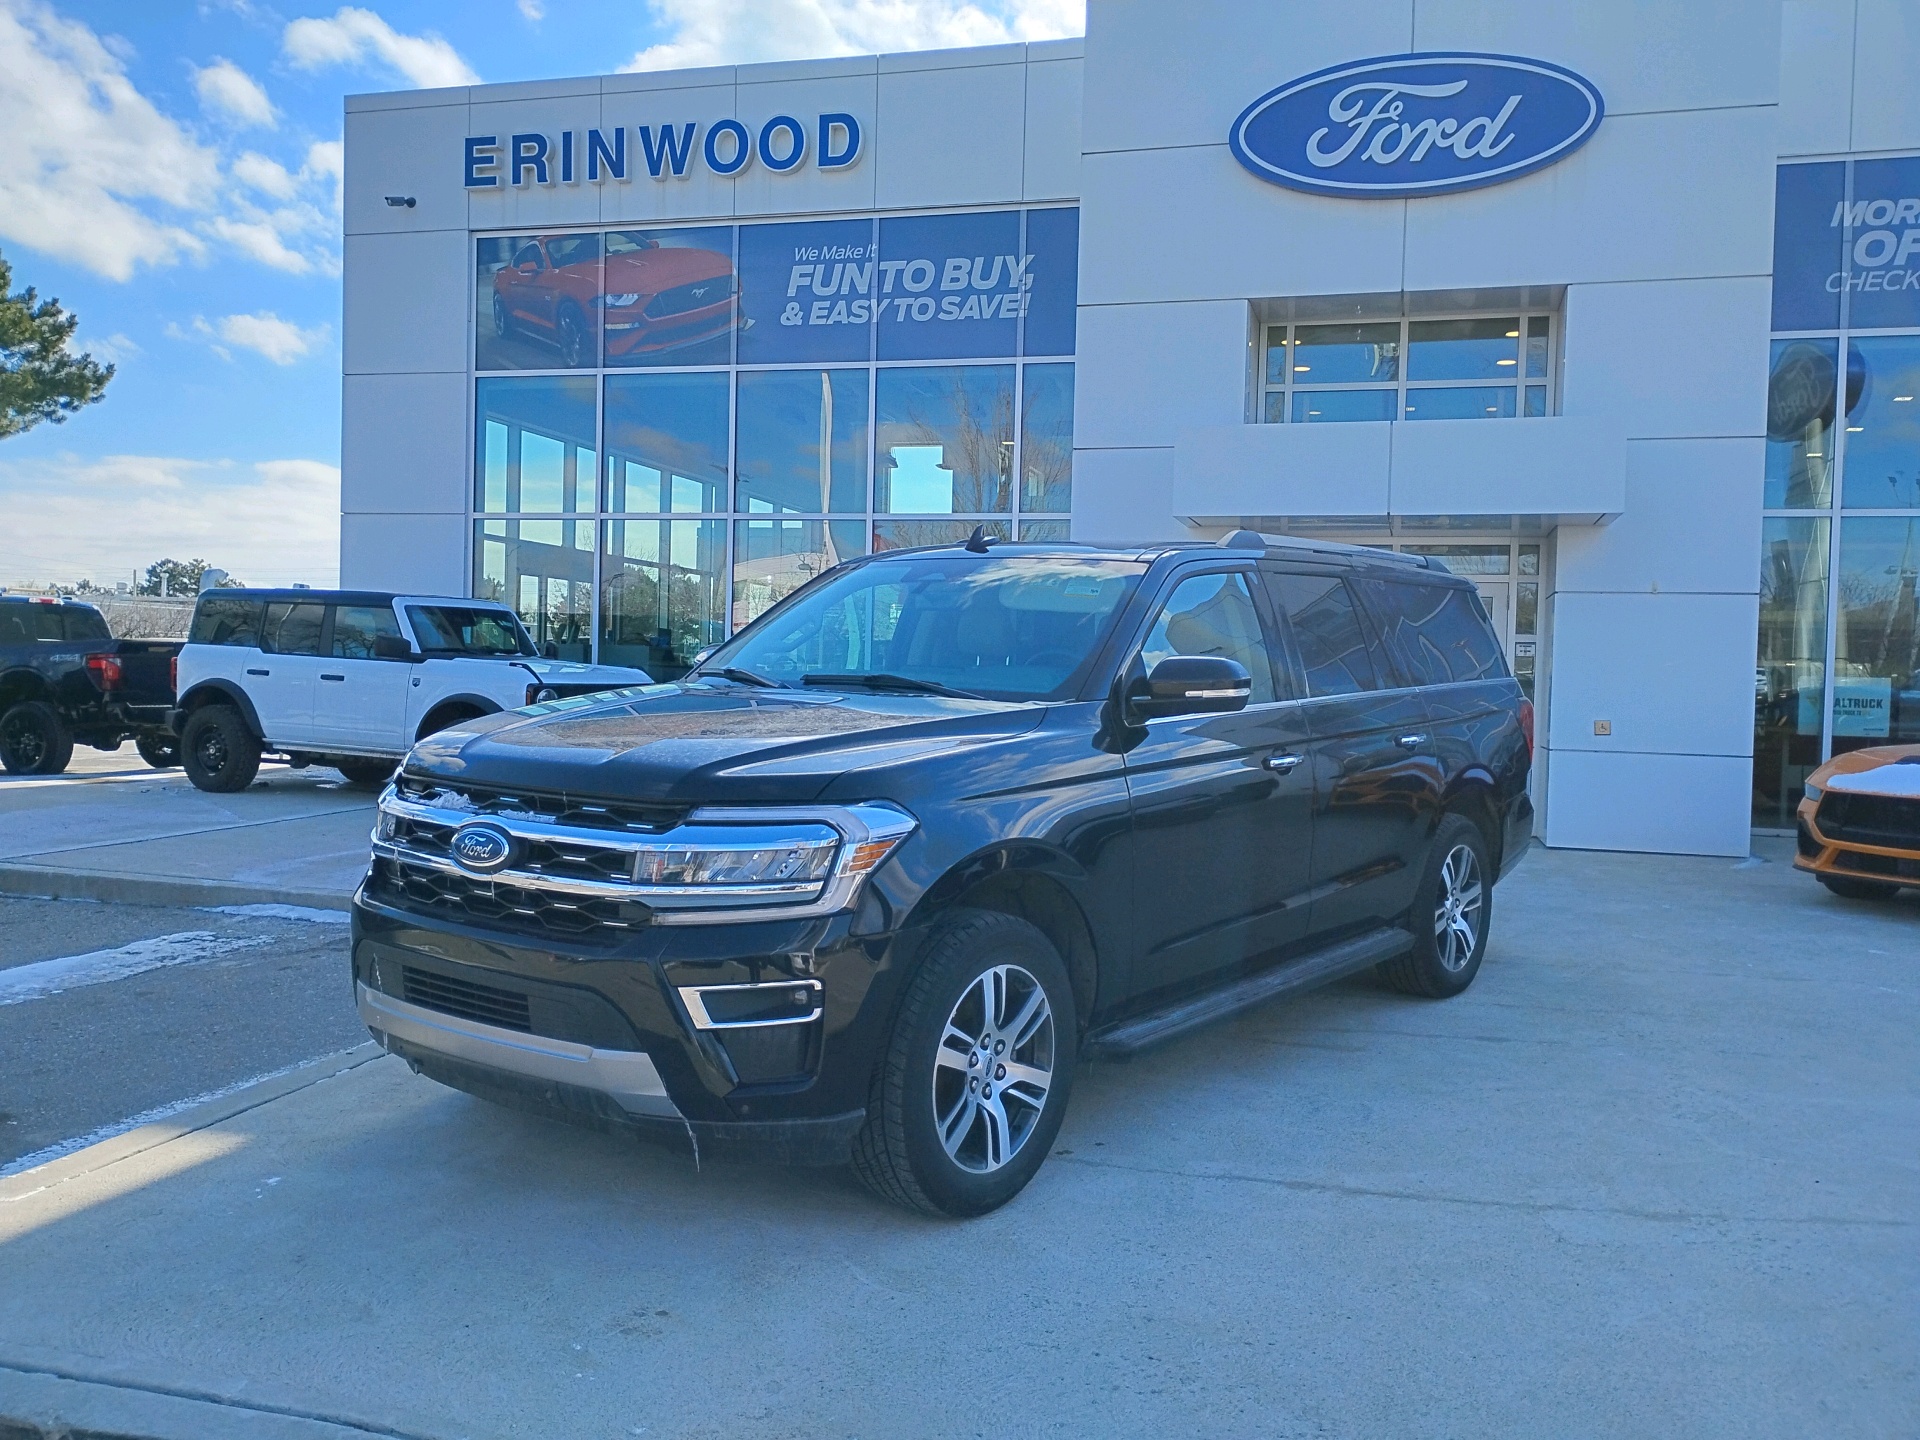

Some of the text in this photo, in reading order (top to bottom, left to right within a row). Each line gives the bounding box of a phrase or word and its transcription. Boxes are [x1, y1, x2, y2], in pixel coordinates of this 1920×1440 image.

[1306, 79, 1522, 167] Ford
[464, 112, 863, 190] ERINWOOD
[1830, 198, 1920, 227] MOR
[795, 243, 877, 261] We Make It
[786, 254, 1035, 296] FUN TO BUY,
[1825, 269, 1920, 292] CHECK
[780, 292, 1032, 326] & EASY TO SAVE!
[1833, 698, 1883, 708] ALTRUCK
[461, 834, 493, 858] Ford
